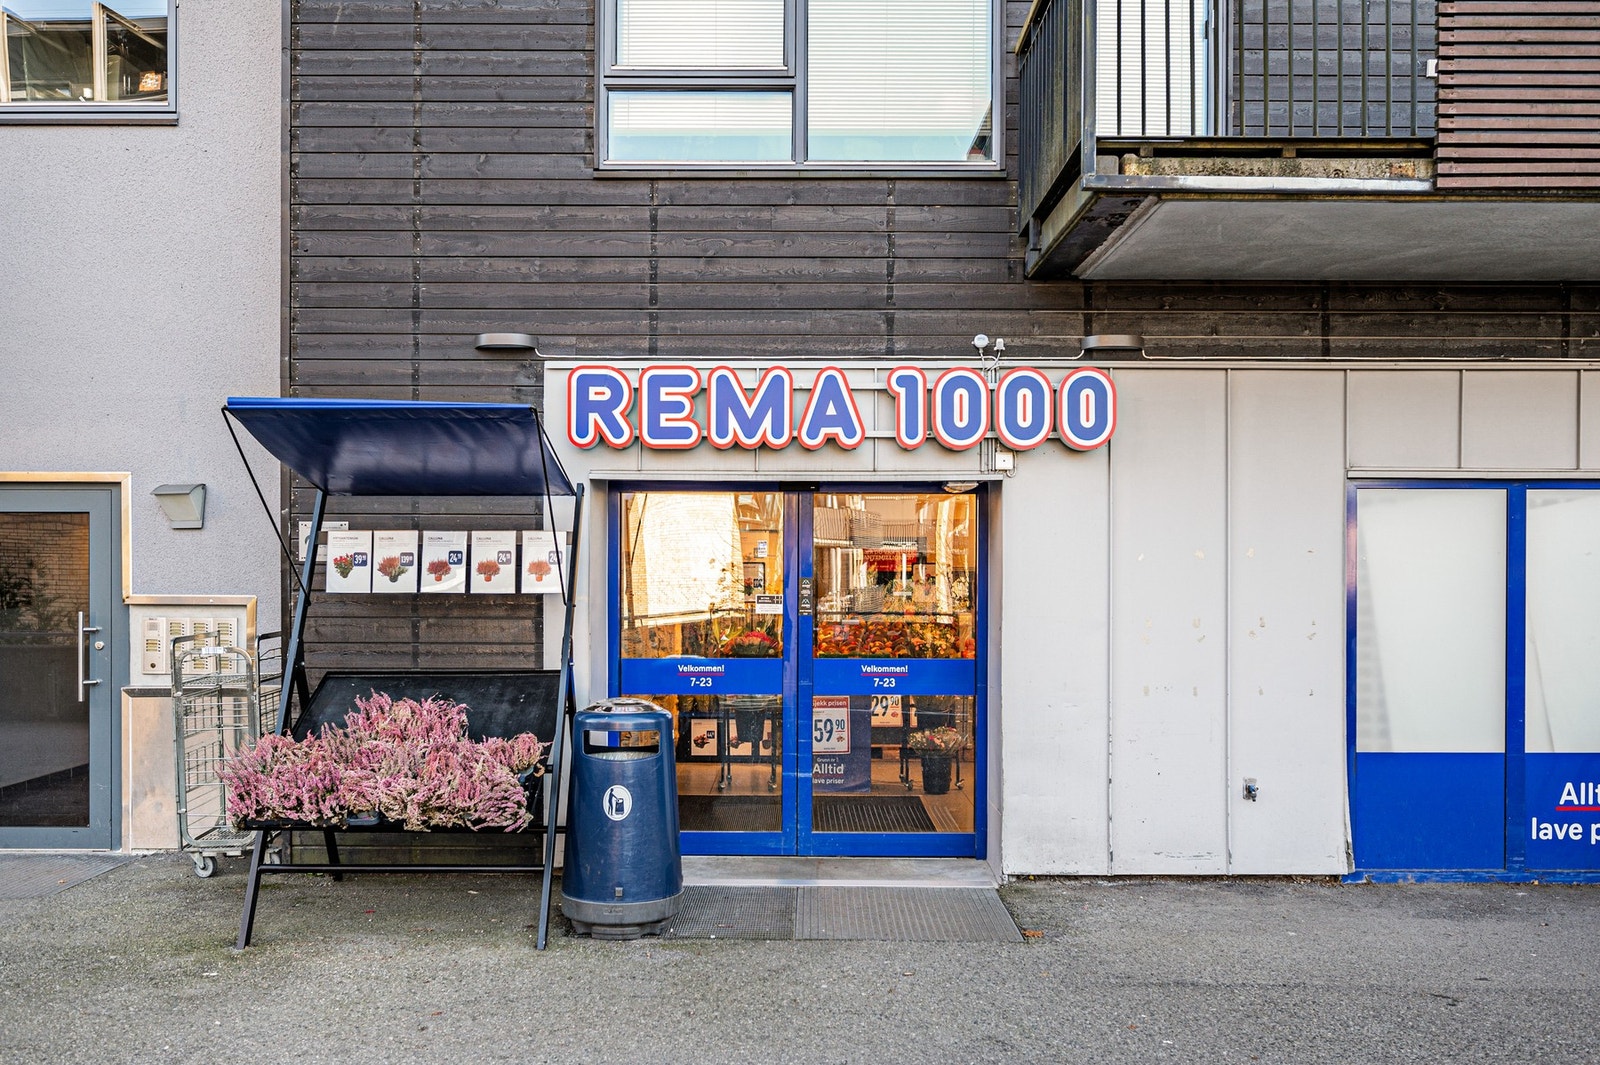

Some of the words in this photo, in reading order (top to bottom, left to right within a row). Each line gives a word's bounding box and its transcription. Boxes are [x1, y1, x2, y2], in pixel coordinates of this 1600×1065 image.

[568, 365, 865, 450] REMA
[887, 366, 1117, 451] 1000
[677, 664, 725, 672] Velkommen!
[861, 664, 908, 673] Velkommen!
[690, 677, 712, 687] 7-23
[873, 677, 896, 688] 7-23
[828, 700, 847, 708] prisen
[872, 695, 889, 717] 29
[890, 696, 899, 706] 90
[813, 718, 834, 743] 59
[835, 719, 846, 730] 90
[812, 763, 844, 775] Alltid
[826, 777, 845, 786] priser
[1531, 817, 1583, 841] lave
